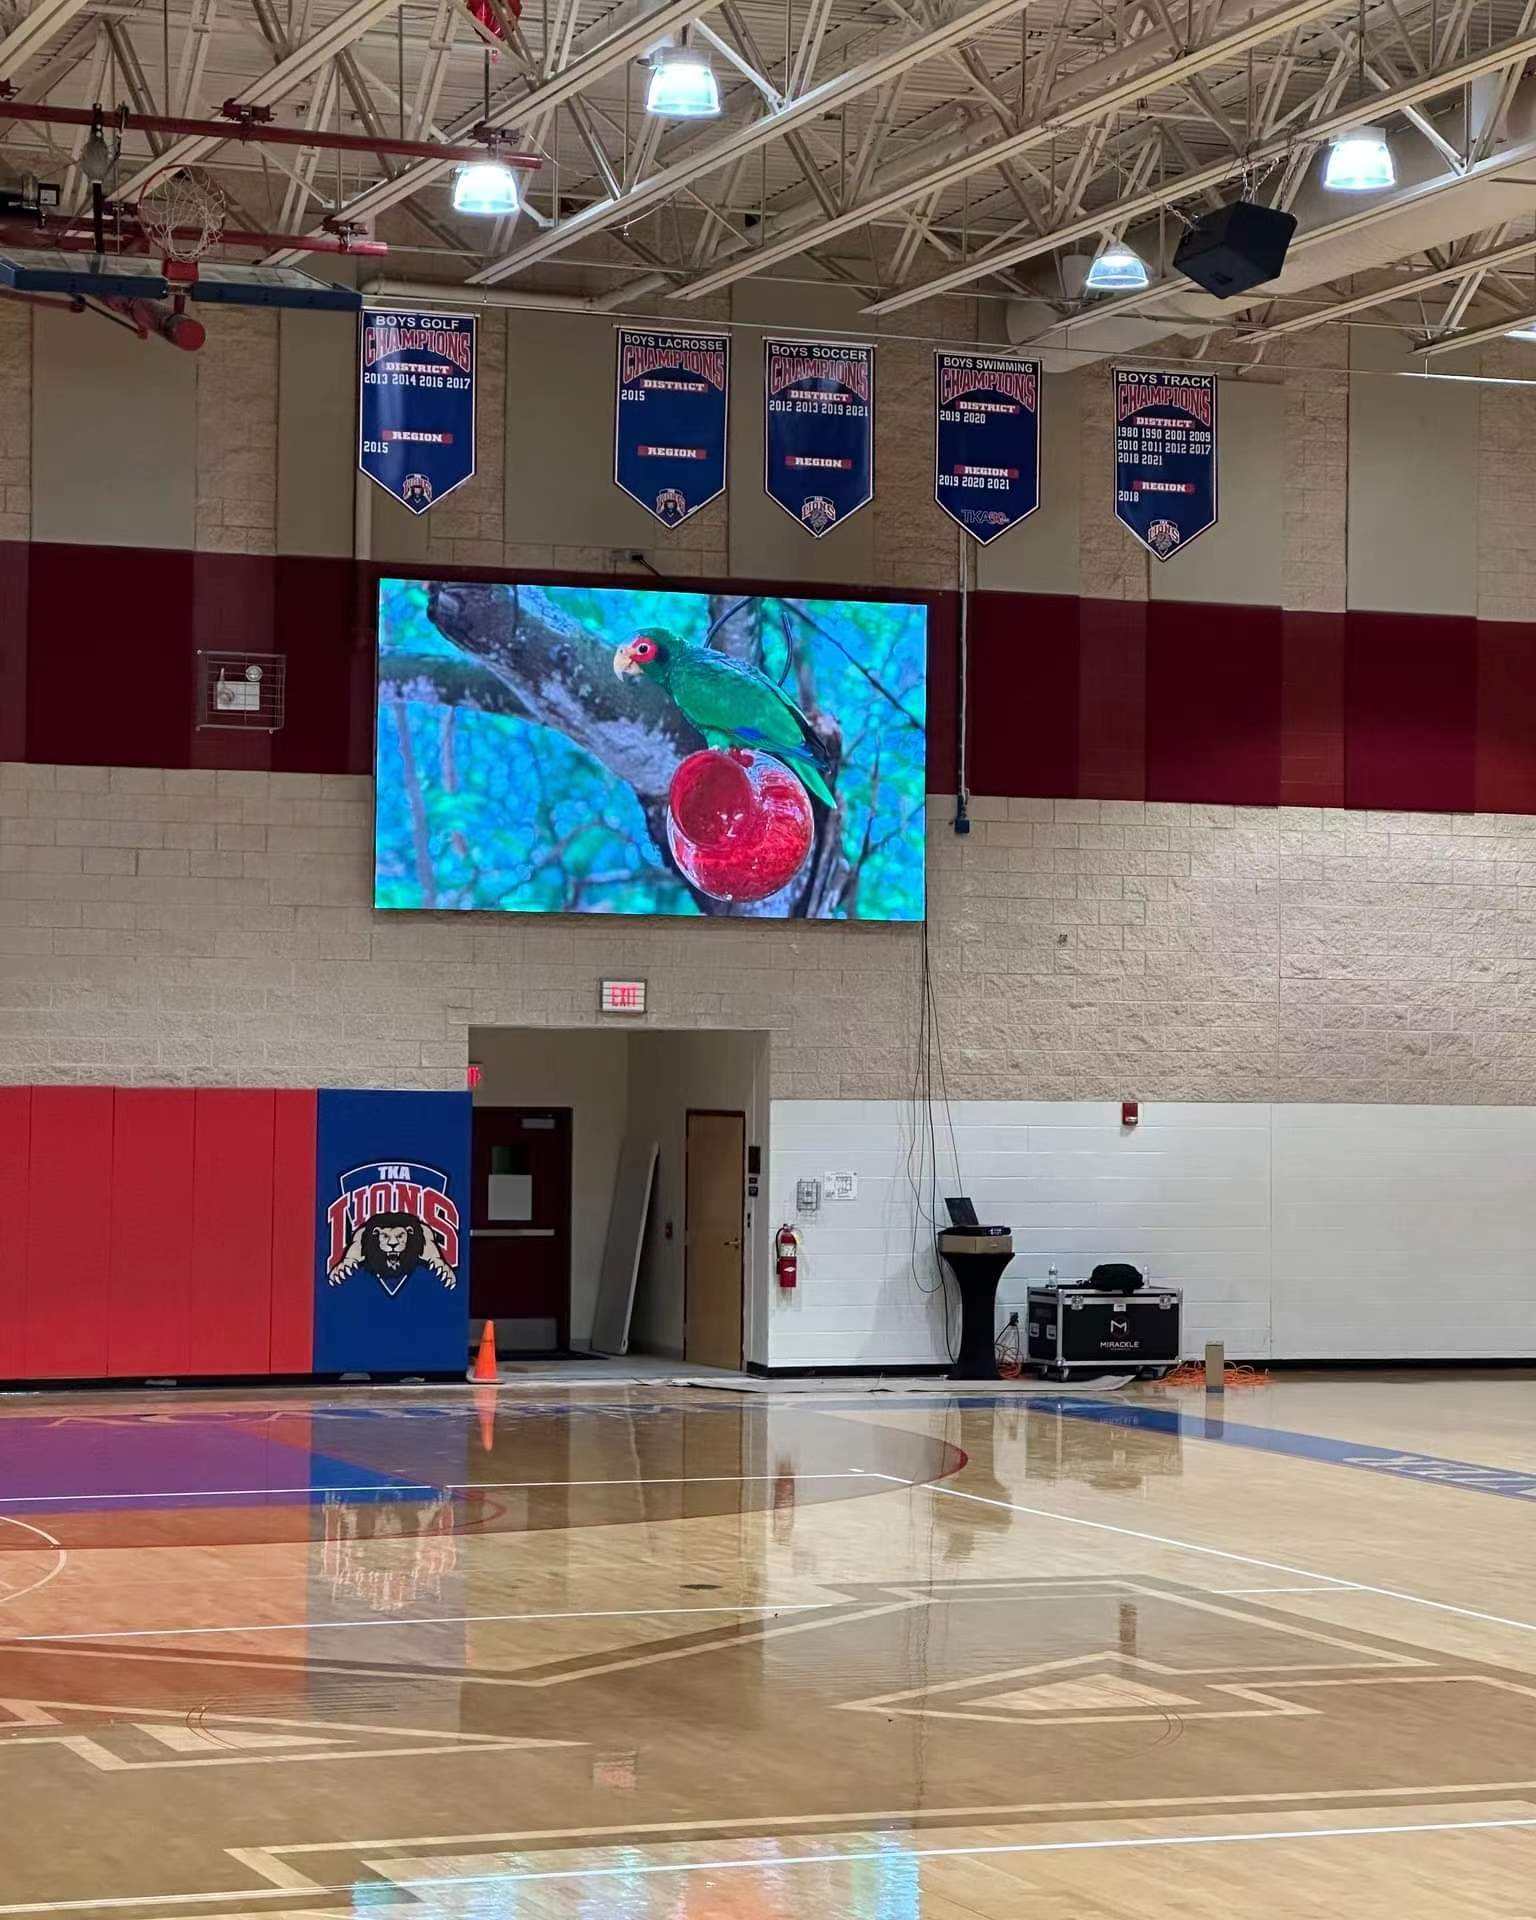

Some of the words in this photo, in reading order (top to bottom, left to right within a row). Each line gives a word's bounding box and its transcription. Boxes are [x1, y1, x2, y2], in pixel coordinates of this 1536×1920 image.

[375, 315, 416, 327] BOYS
[421, 318, 460, 330] GOLF
[624, 334, 655, 346] BOYS
[658, 337, 723, 350] LACROSSE
[365, 327, 471, 373] CHAMPIONS
[771, 345, 808, 357] BOYS
[812, 347, 867, 360] SOCCER
[385, 362, 450, 374] DISTRICT
[623, 345, 724, 391] CHAMPIONS
[944, 357, 973, 368] BOYS
[976, 360, 1033, 373] SWIMMING
[364, 372, 388, 385] 2013
[392, 373, 417, 386] 2014
[419, 375, 443, 388] 2016
[446, 377, 471, 389] 2017
[643, 379, 705, 391] DISTRICT
[770, 355, 868, 401] CHAMPIONS
[1118, 372, 1158, 384] BOYS
[1162, 375, 1211, 387] TRACK
[621, 389, 646, 401] 2015
[790, 390, 849, 402] DISTRICT
[940, 368, 1036, 413] CHAMPIONS
[769, 400, 792, 411] 2012
[795, 401, 818, 413] 2013
[821, 403, 843, 415] 2019
[845, 404, 868, 416] 2021
[959, 401, 1016, 413] DISTRICT
[1118, 383, 1211, 427] CHAMPIONS
[939, 410, 960, 422] 2019
[963, 412, 986, 424] 2020
[1136, 416, 1192, 428] DISTRICT
[392, 431, 443, 442] REGION
[1118, 426, 1138, 438] 1980
[1141, 428, 1162, 439] 1990
[1165, 429, 1186, 441] 2001
[1189, 431, 1211, 442] 2009
[363, 440, 389, 453] 2015
[647, 446, 697, 458] REGION
[1118, 439, 1138, 451] 2010
[1141, 441, 1162, 452] 2011
[1165, 442, 1187, 454] 2012
[1189, 444, 1211, 455] 2017
[795, 456, 843, 468] REGION
[1141, 454, 1162, 465] 2021
[964, 466, 1009, 477] REGION
[938, 475, 959, 486] 2019
[961, 476, 985, 488] 2020
[987, 478, 1010, 490] 2021
[1142, 481, 1187, 492] REGION
[1118, 490, 1139, 502] 2018
[611, 984, 636, 1008] EXIT
[377, 1165, 411, 1180] TKA
[326, 1181, 460, 1274] LIONS
